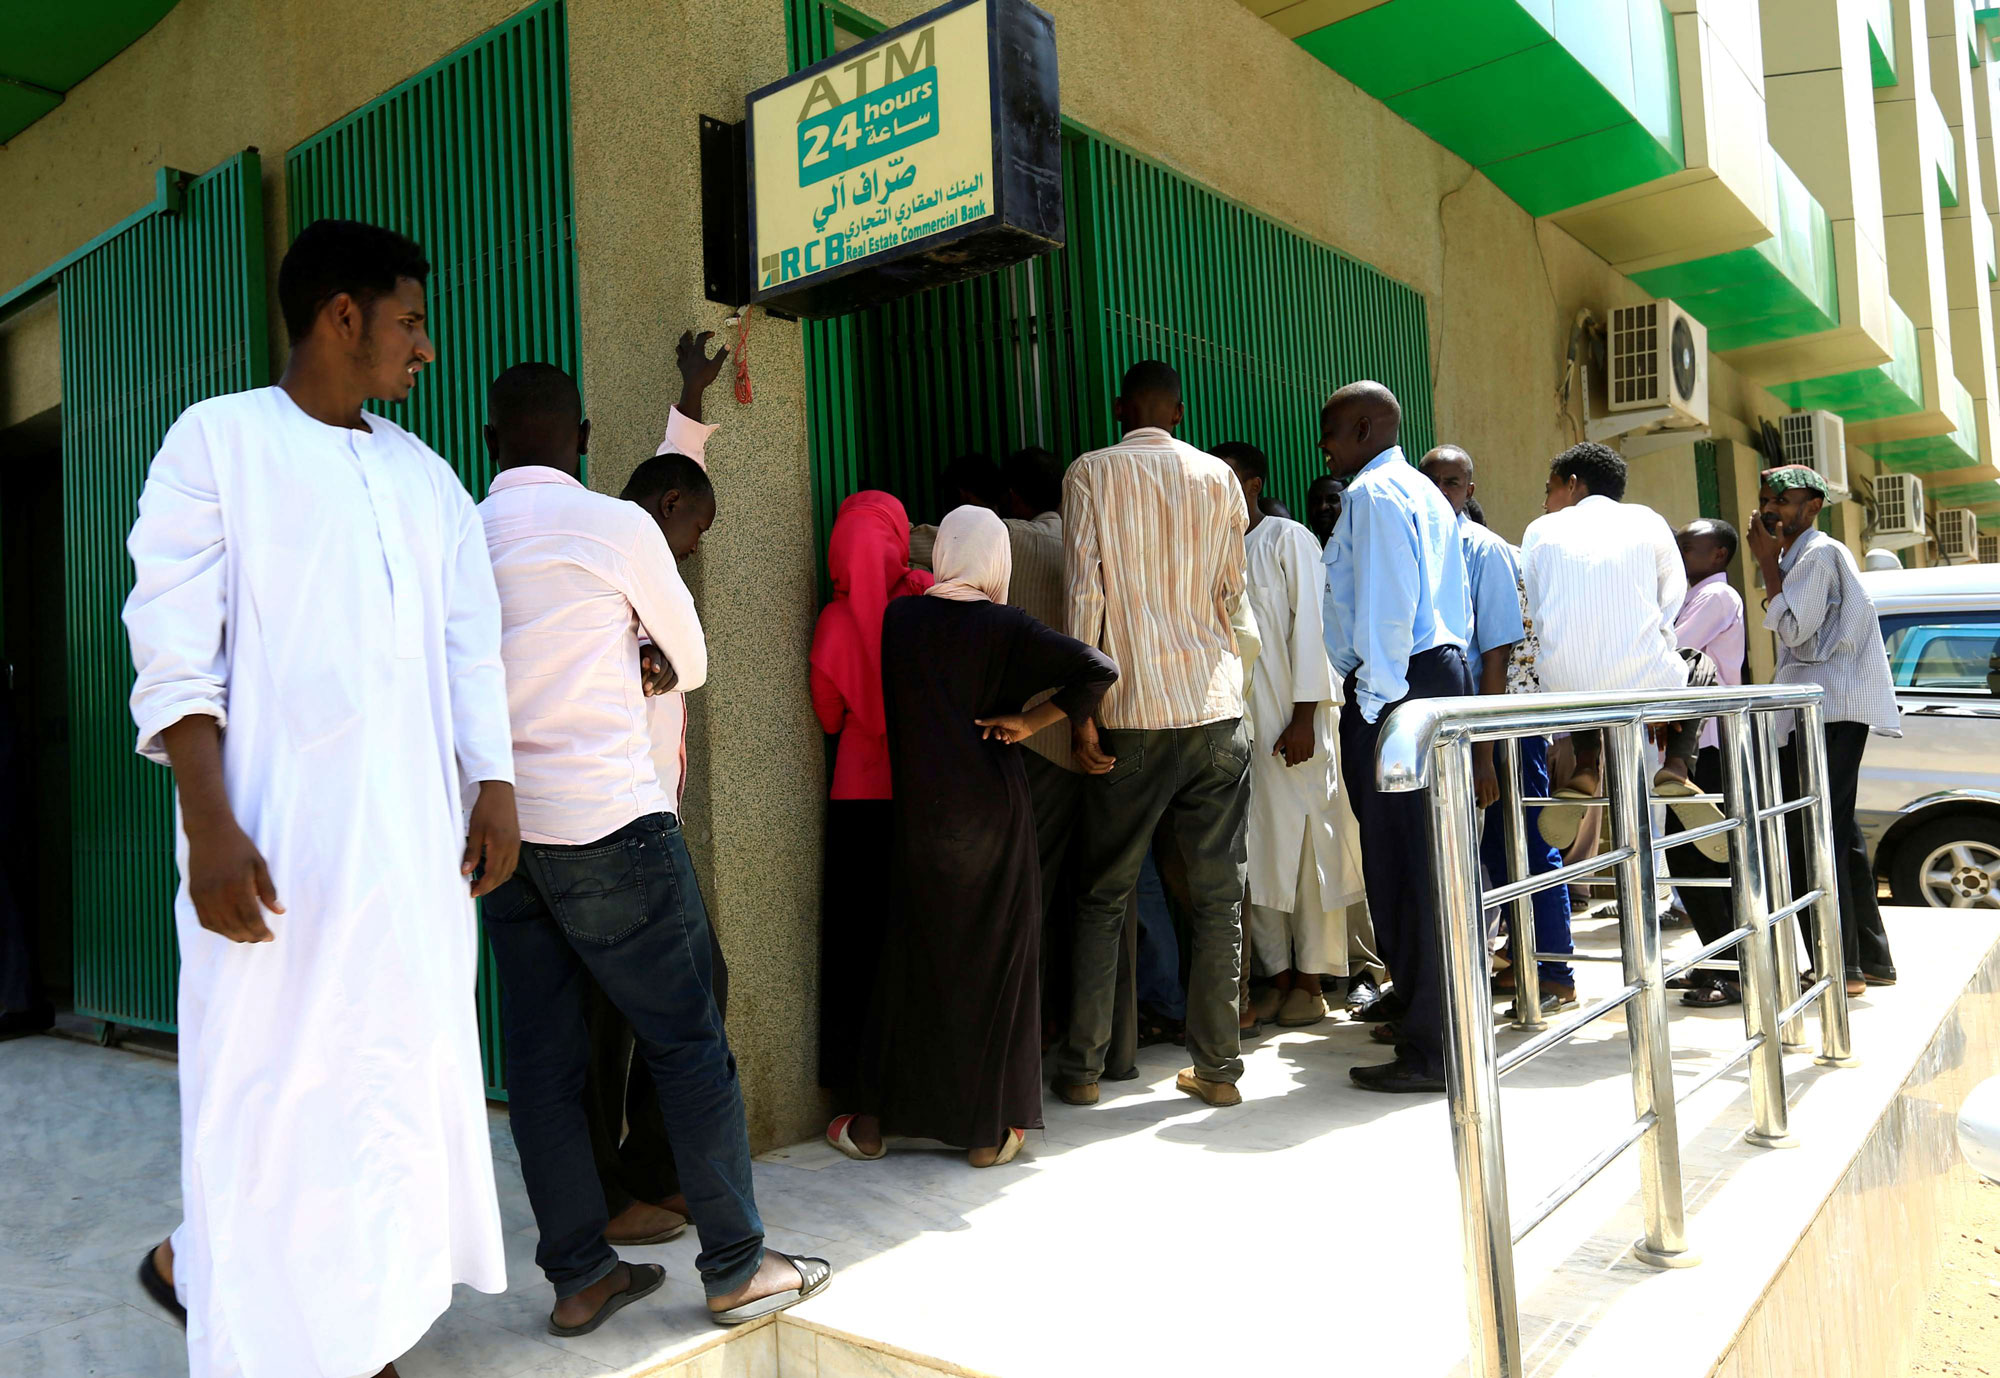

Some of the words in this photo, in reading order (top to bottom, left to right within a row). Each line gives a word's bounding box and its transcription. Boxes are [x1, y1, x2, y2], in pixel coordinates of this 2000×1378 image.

[796, 26, 935, 123] ATM
[802, 111, 862, 168] 24
[864, 81, 932, 123] hours
[865, 112, 931, 145] ساعة
[894, 186, 943, 226] العقاري
[946, 172, 983, 202] البنك
[845, 205, 892, 243] التجاري
[846, 241, 866, 261] Real
[868, 231, 898, 254] Estate
[901, 207, 958, 242] Commercial
[961, 199, 986, 222] Bank
[781, 232, 845, 282] RCB
